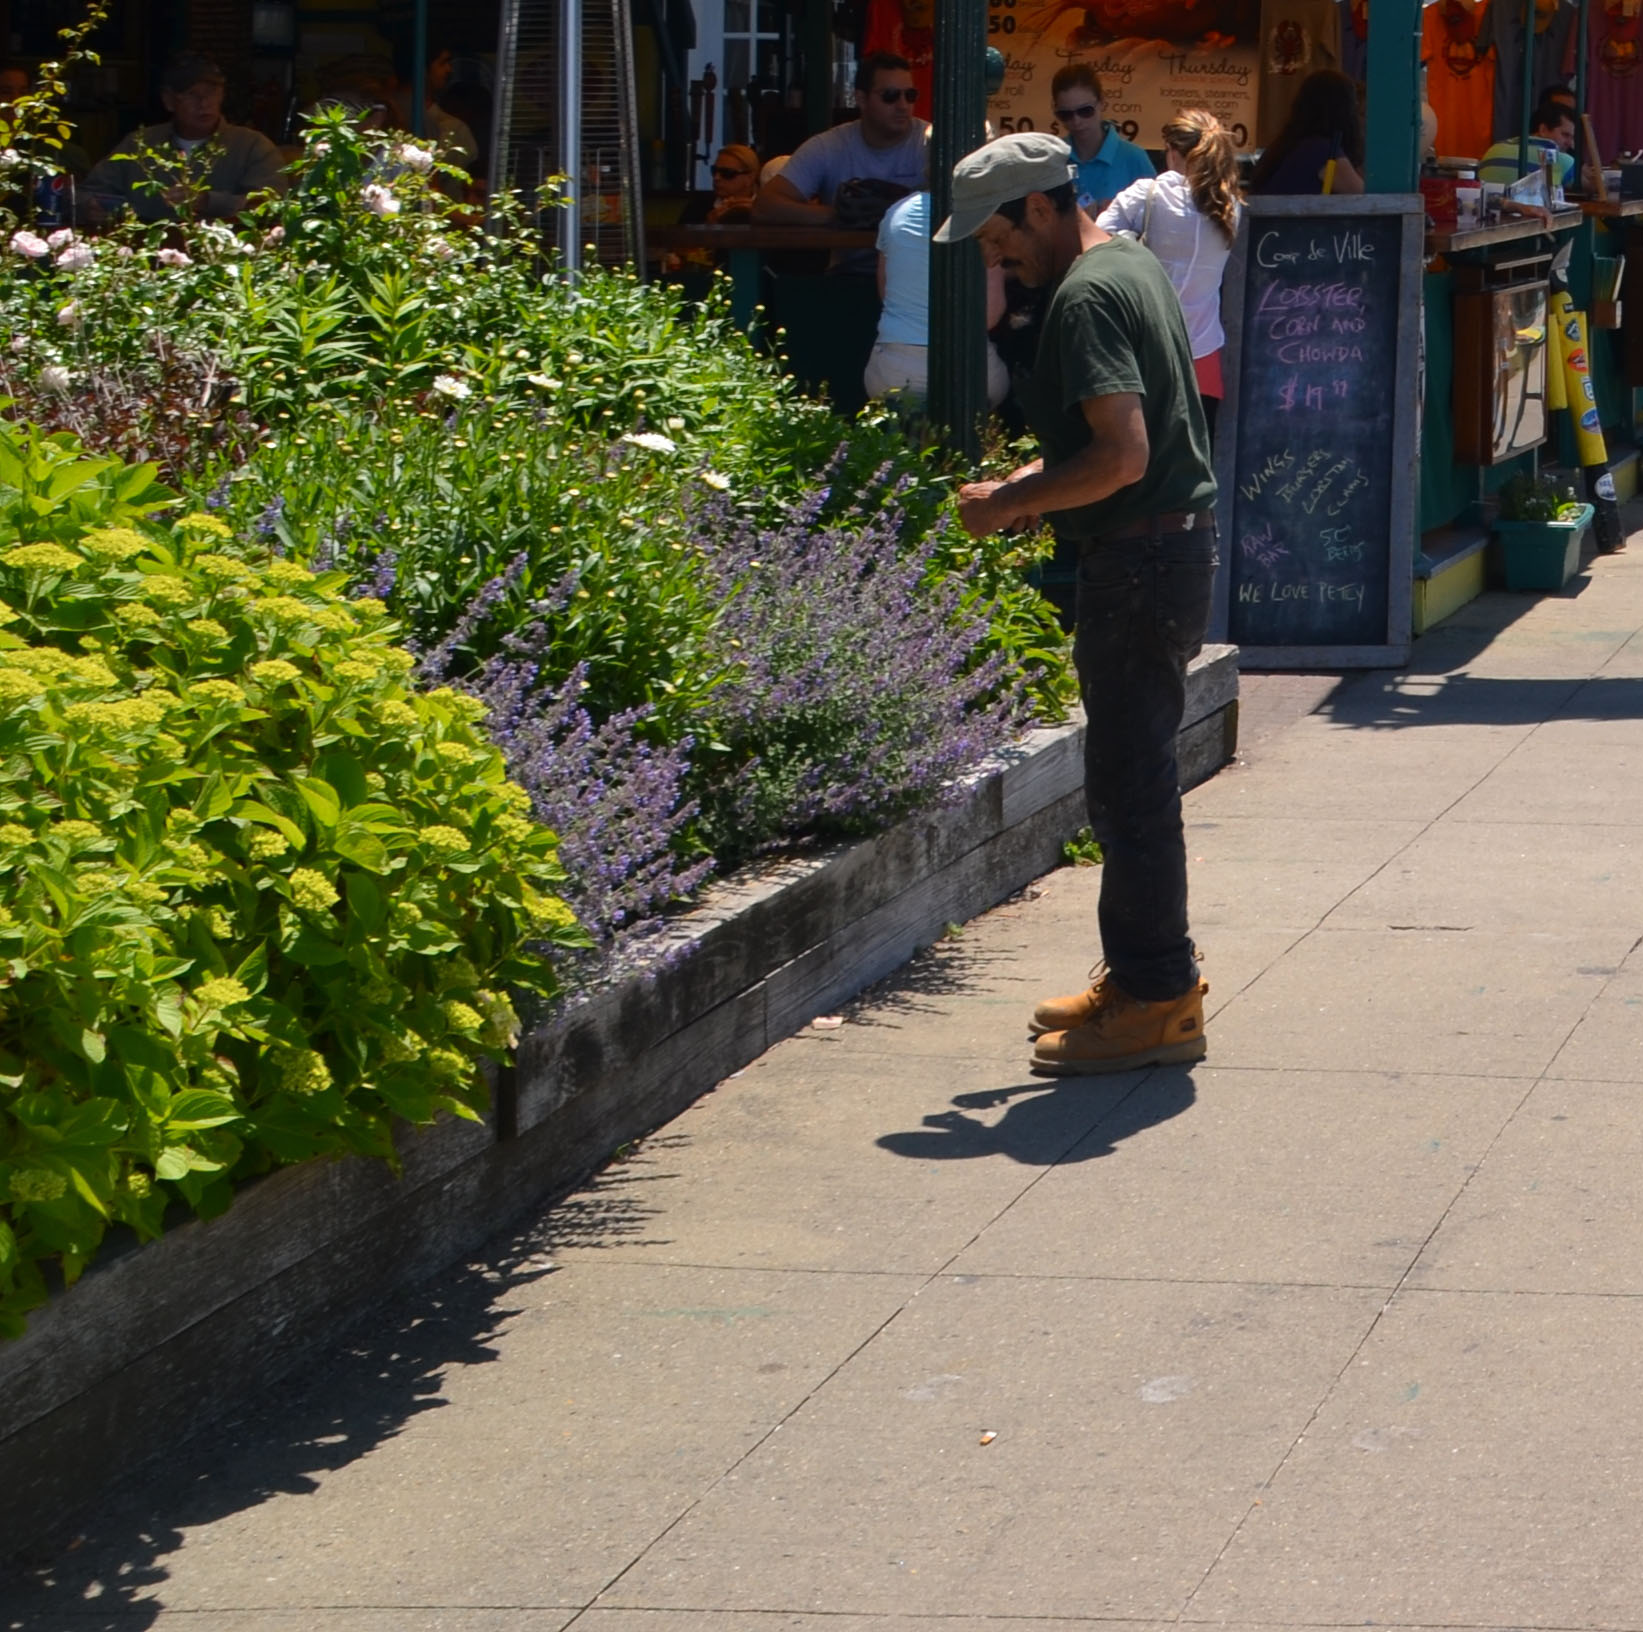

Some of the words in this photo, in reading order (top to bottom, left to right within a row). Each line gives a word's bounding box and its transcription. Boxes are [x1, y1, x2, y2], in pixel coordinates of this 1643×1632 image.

[1158, 50, 1252, 86] Thursday
[1334, 232, 1375, 263] Ville
[1278, 341, 1363, 364] CHOWDA
[1240, 448, 1296, 501] WINGS
[1241, 523, 1274, 557] RAW
[1239, 584, 1261, 603] WE
[1272, 581, 1310, 601] LOVE
